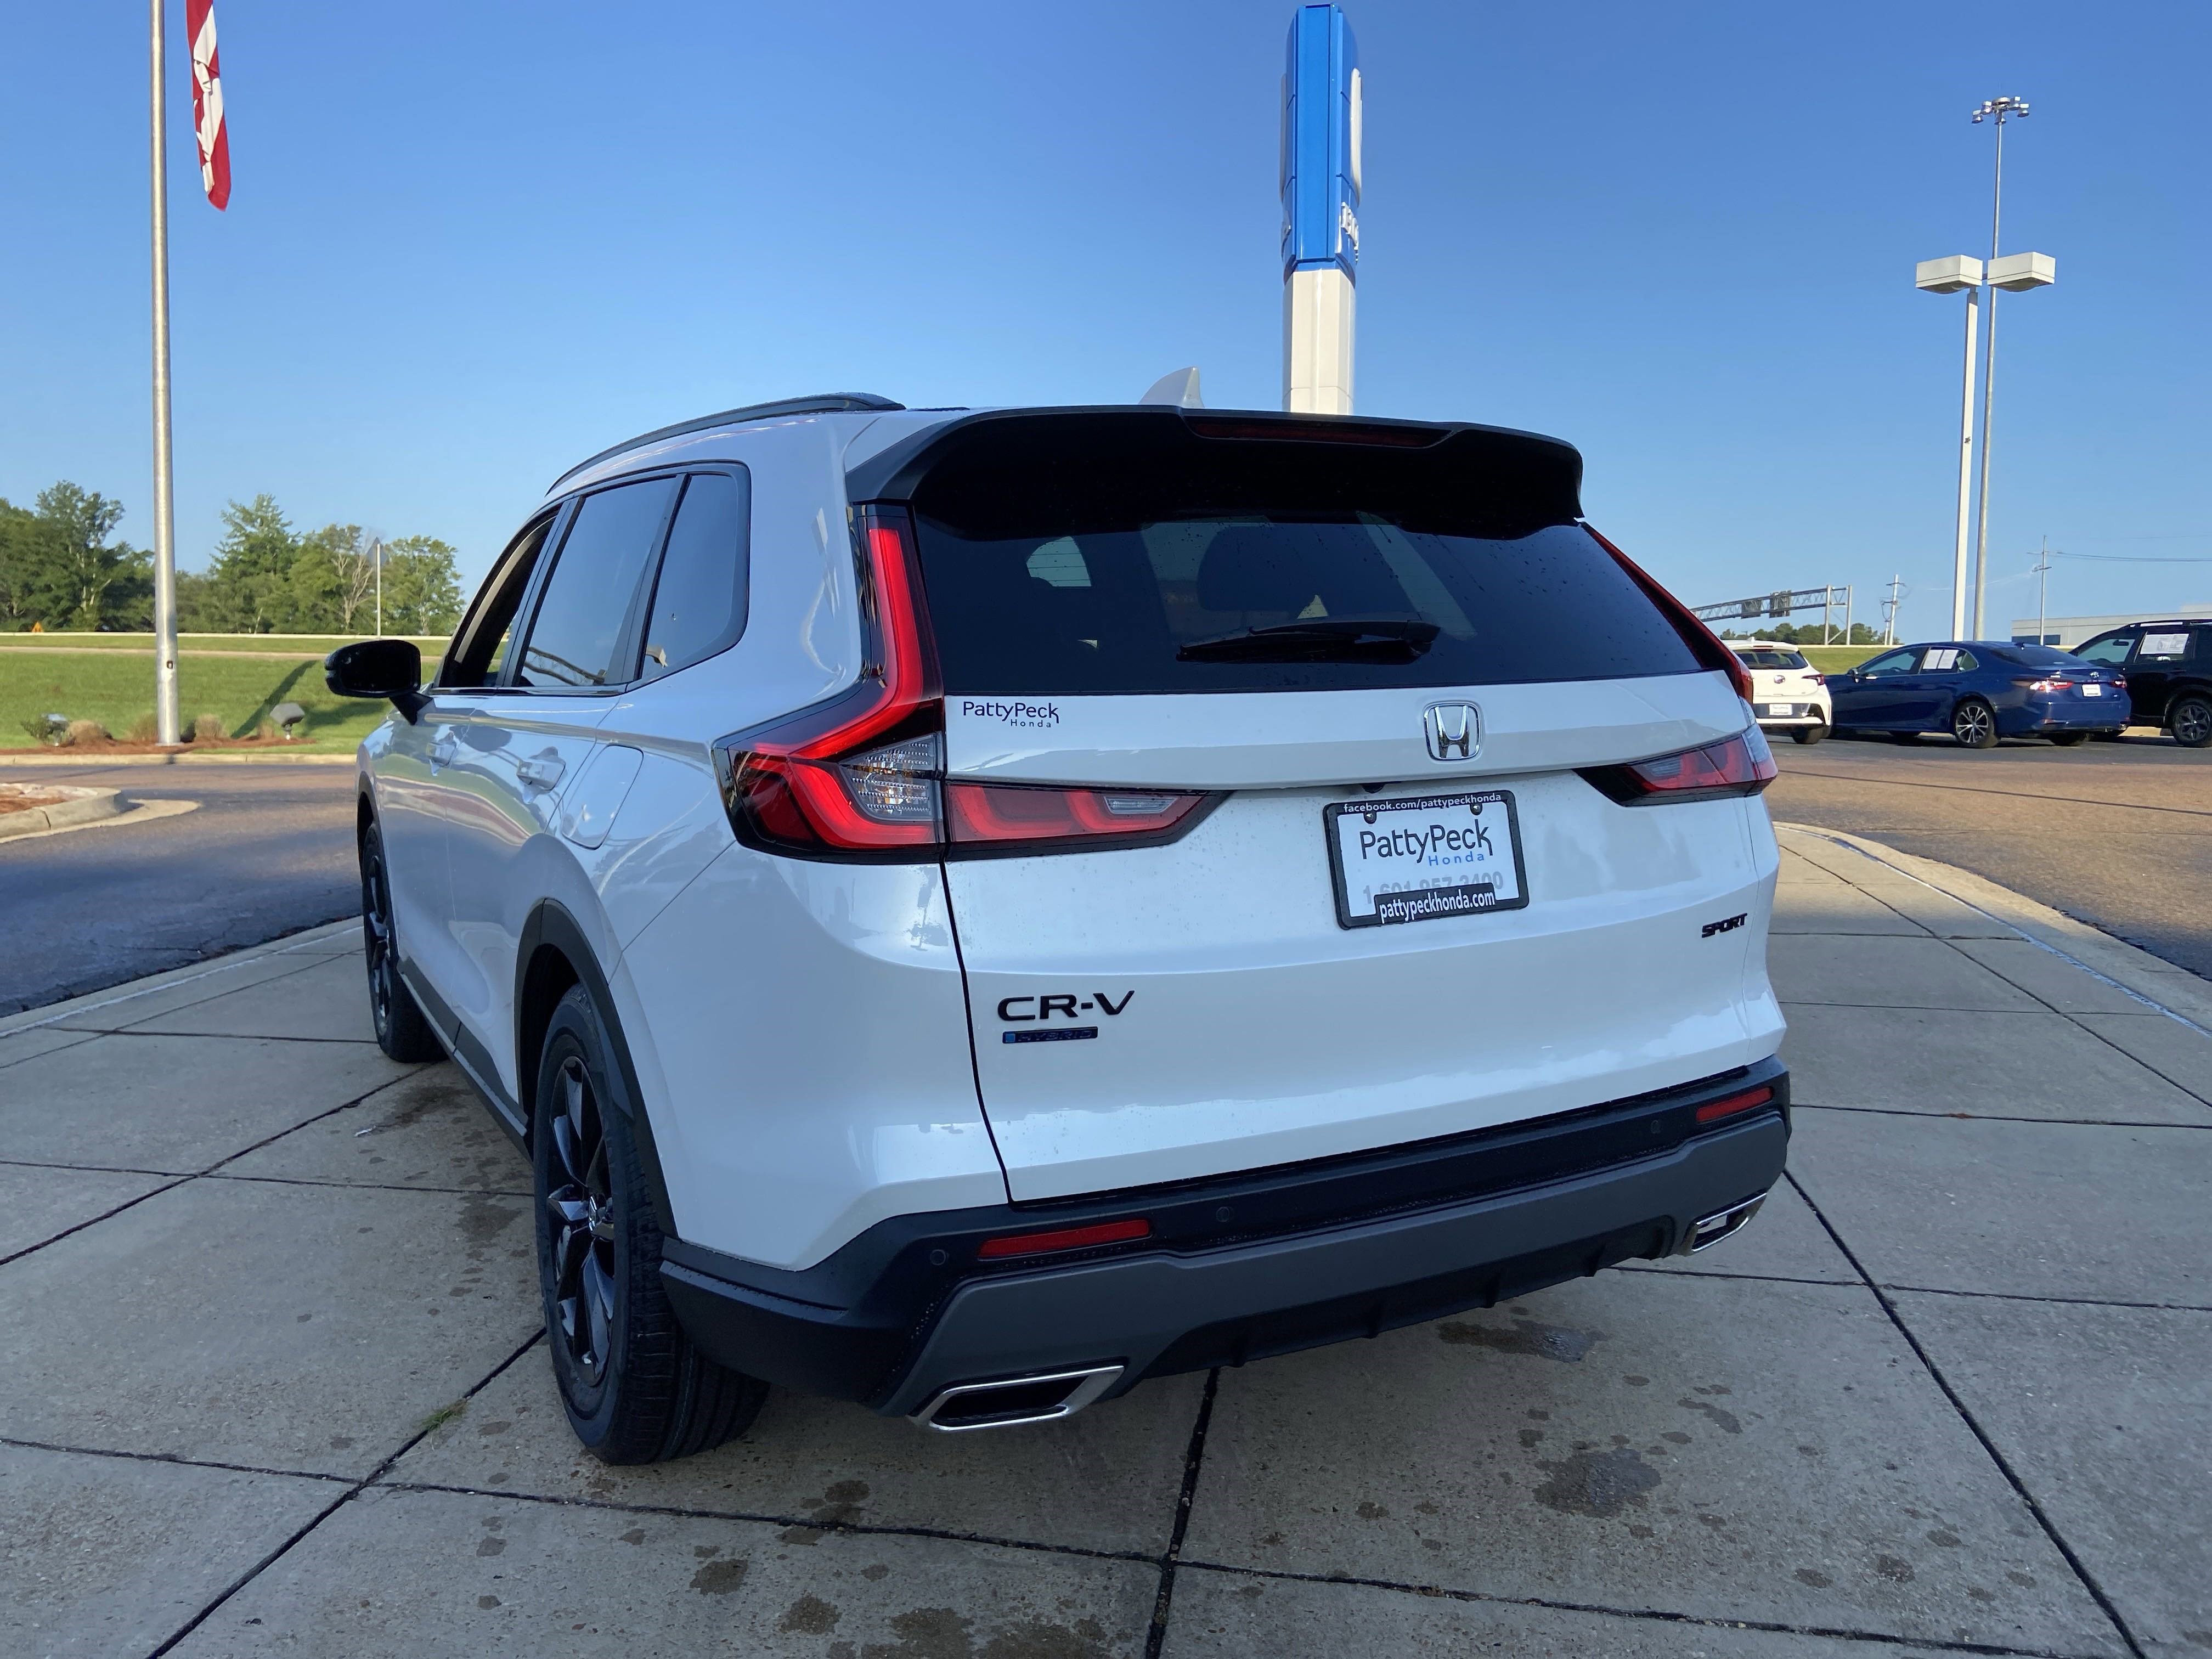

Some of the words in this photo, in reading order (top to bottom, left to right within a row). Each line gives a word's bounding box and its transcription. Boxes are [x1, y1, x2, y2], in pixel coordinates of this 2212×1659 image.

[963, 701, 1059, 724] PattyPeck
[1011, 719, 1051, 727] Honda
[1344, 793, 1502, 812] facebook.com/pattypeckhonda
[1359, 819, 1493, 864] PattyPeck
[1428, 851, 1485, 866] Honda
[1379, 889, 1496, 924] pattypeckhonda.com
[1701, 913, 1747, 938] SPORT
[997, 990, 1135, 1021] CR-V
